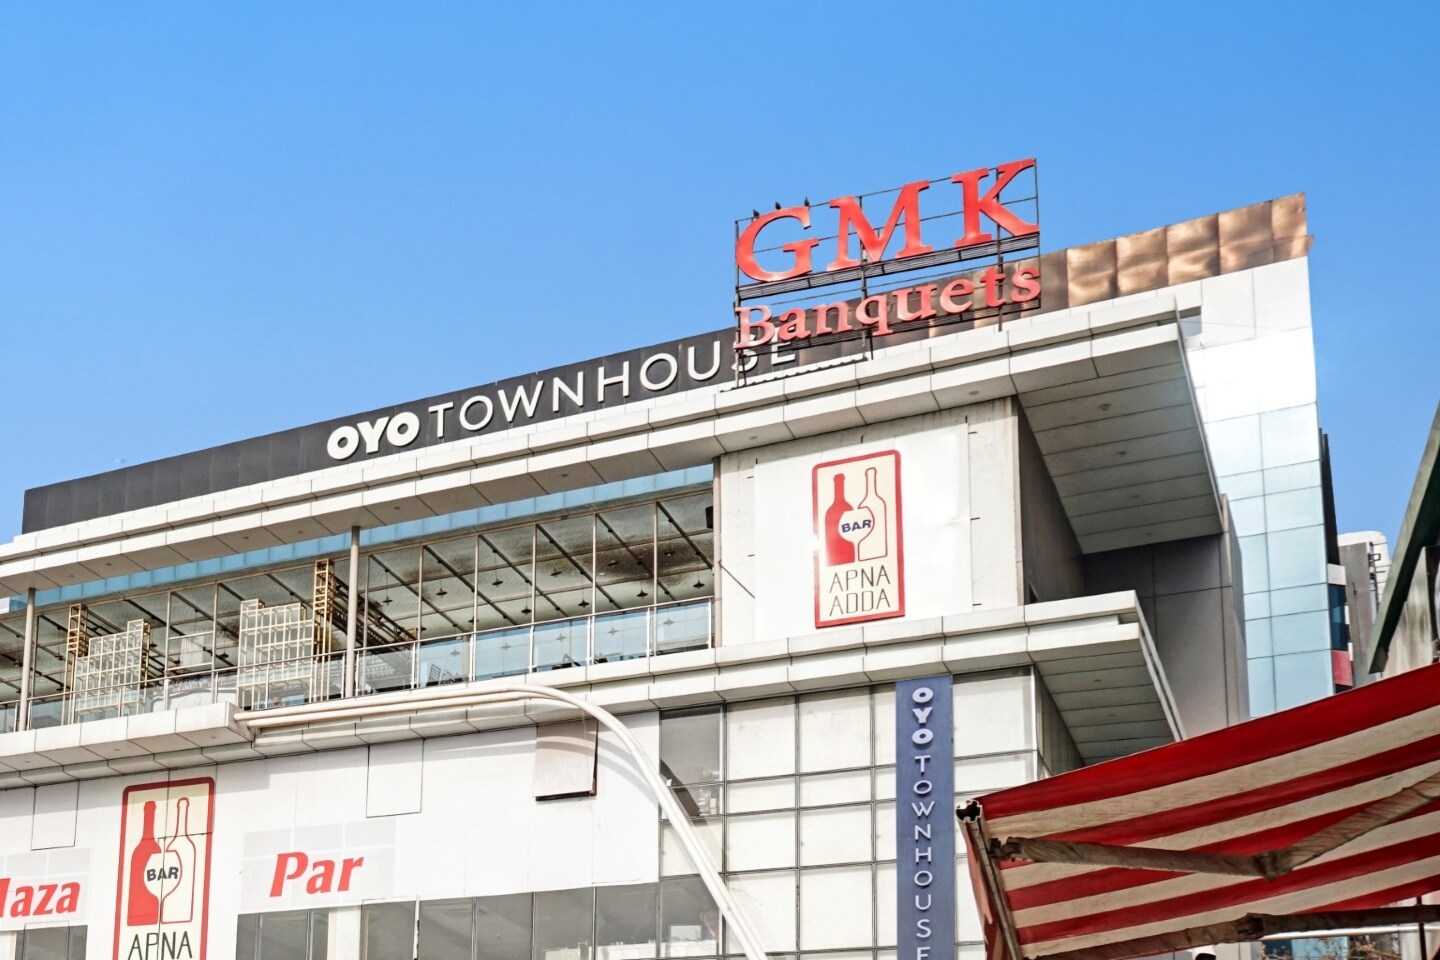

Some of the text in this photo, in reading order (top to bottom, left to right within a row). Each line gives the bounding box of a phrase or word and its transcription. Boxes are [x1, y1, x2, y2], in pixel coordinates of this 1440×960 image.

[734, 158, 1040, 283] GMK
[732, 265, 1042, 350] Banquets
[326, 411, 420, 461] OYO
[841, 518, 872, 534] BAR
[829, 564, 891, 594] APNA
[829, 588, 891, 617] ADDA
[911, 686, 934, 746] OYO
[146, 865, 180, 883] BAR
[269, 851, 365, 899] Par
